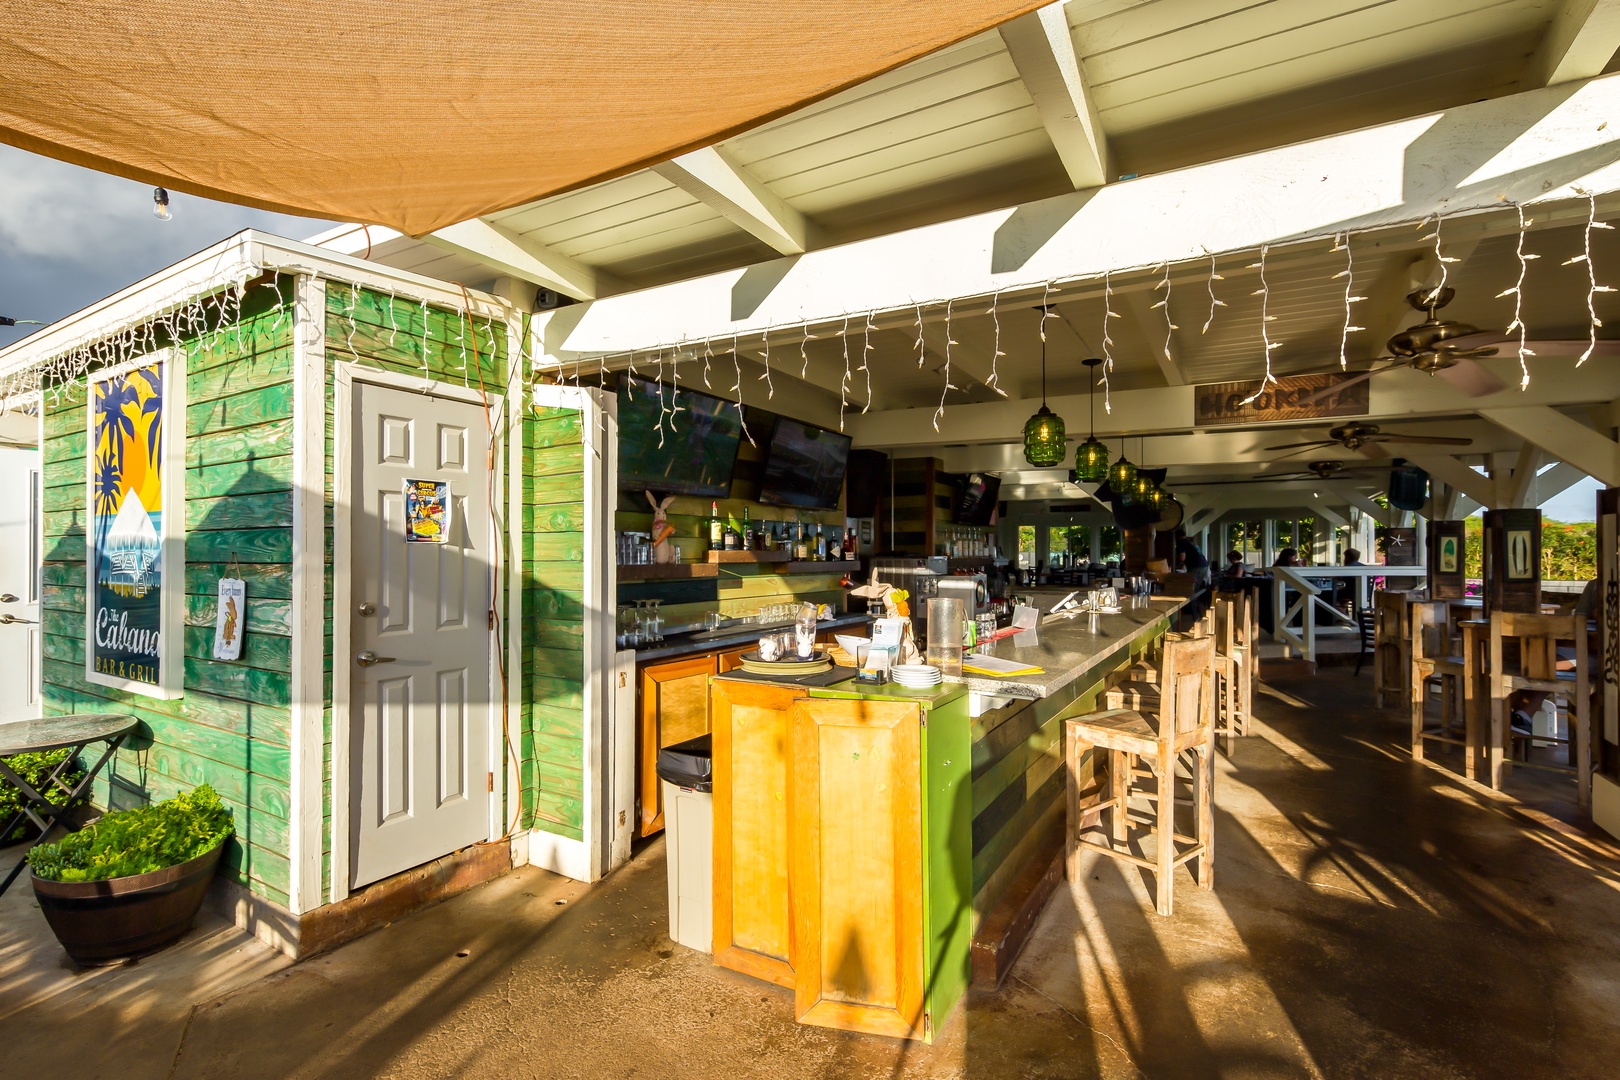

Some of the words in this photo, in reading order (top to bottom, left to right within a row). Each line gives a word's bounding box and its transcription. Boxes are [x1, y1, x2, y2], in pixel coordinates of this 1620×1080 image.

[96, 607, 160, 658] Cabana
[95, 656, 116, 675] BAR
[118, 661, 126, 678] &
[129, 663, 160, 684] GRIL
